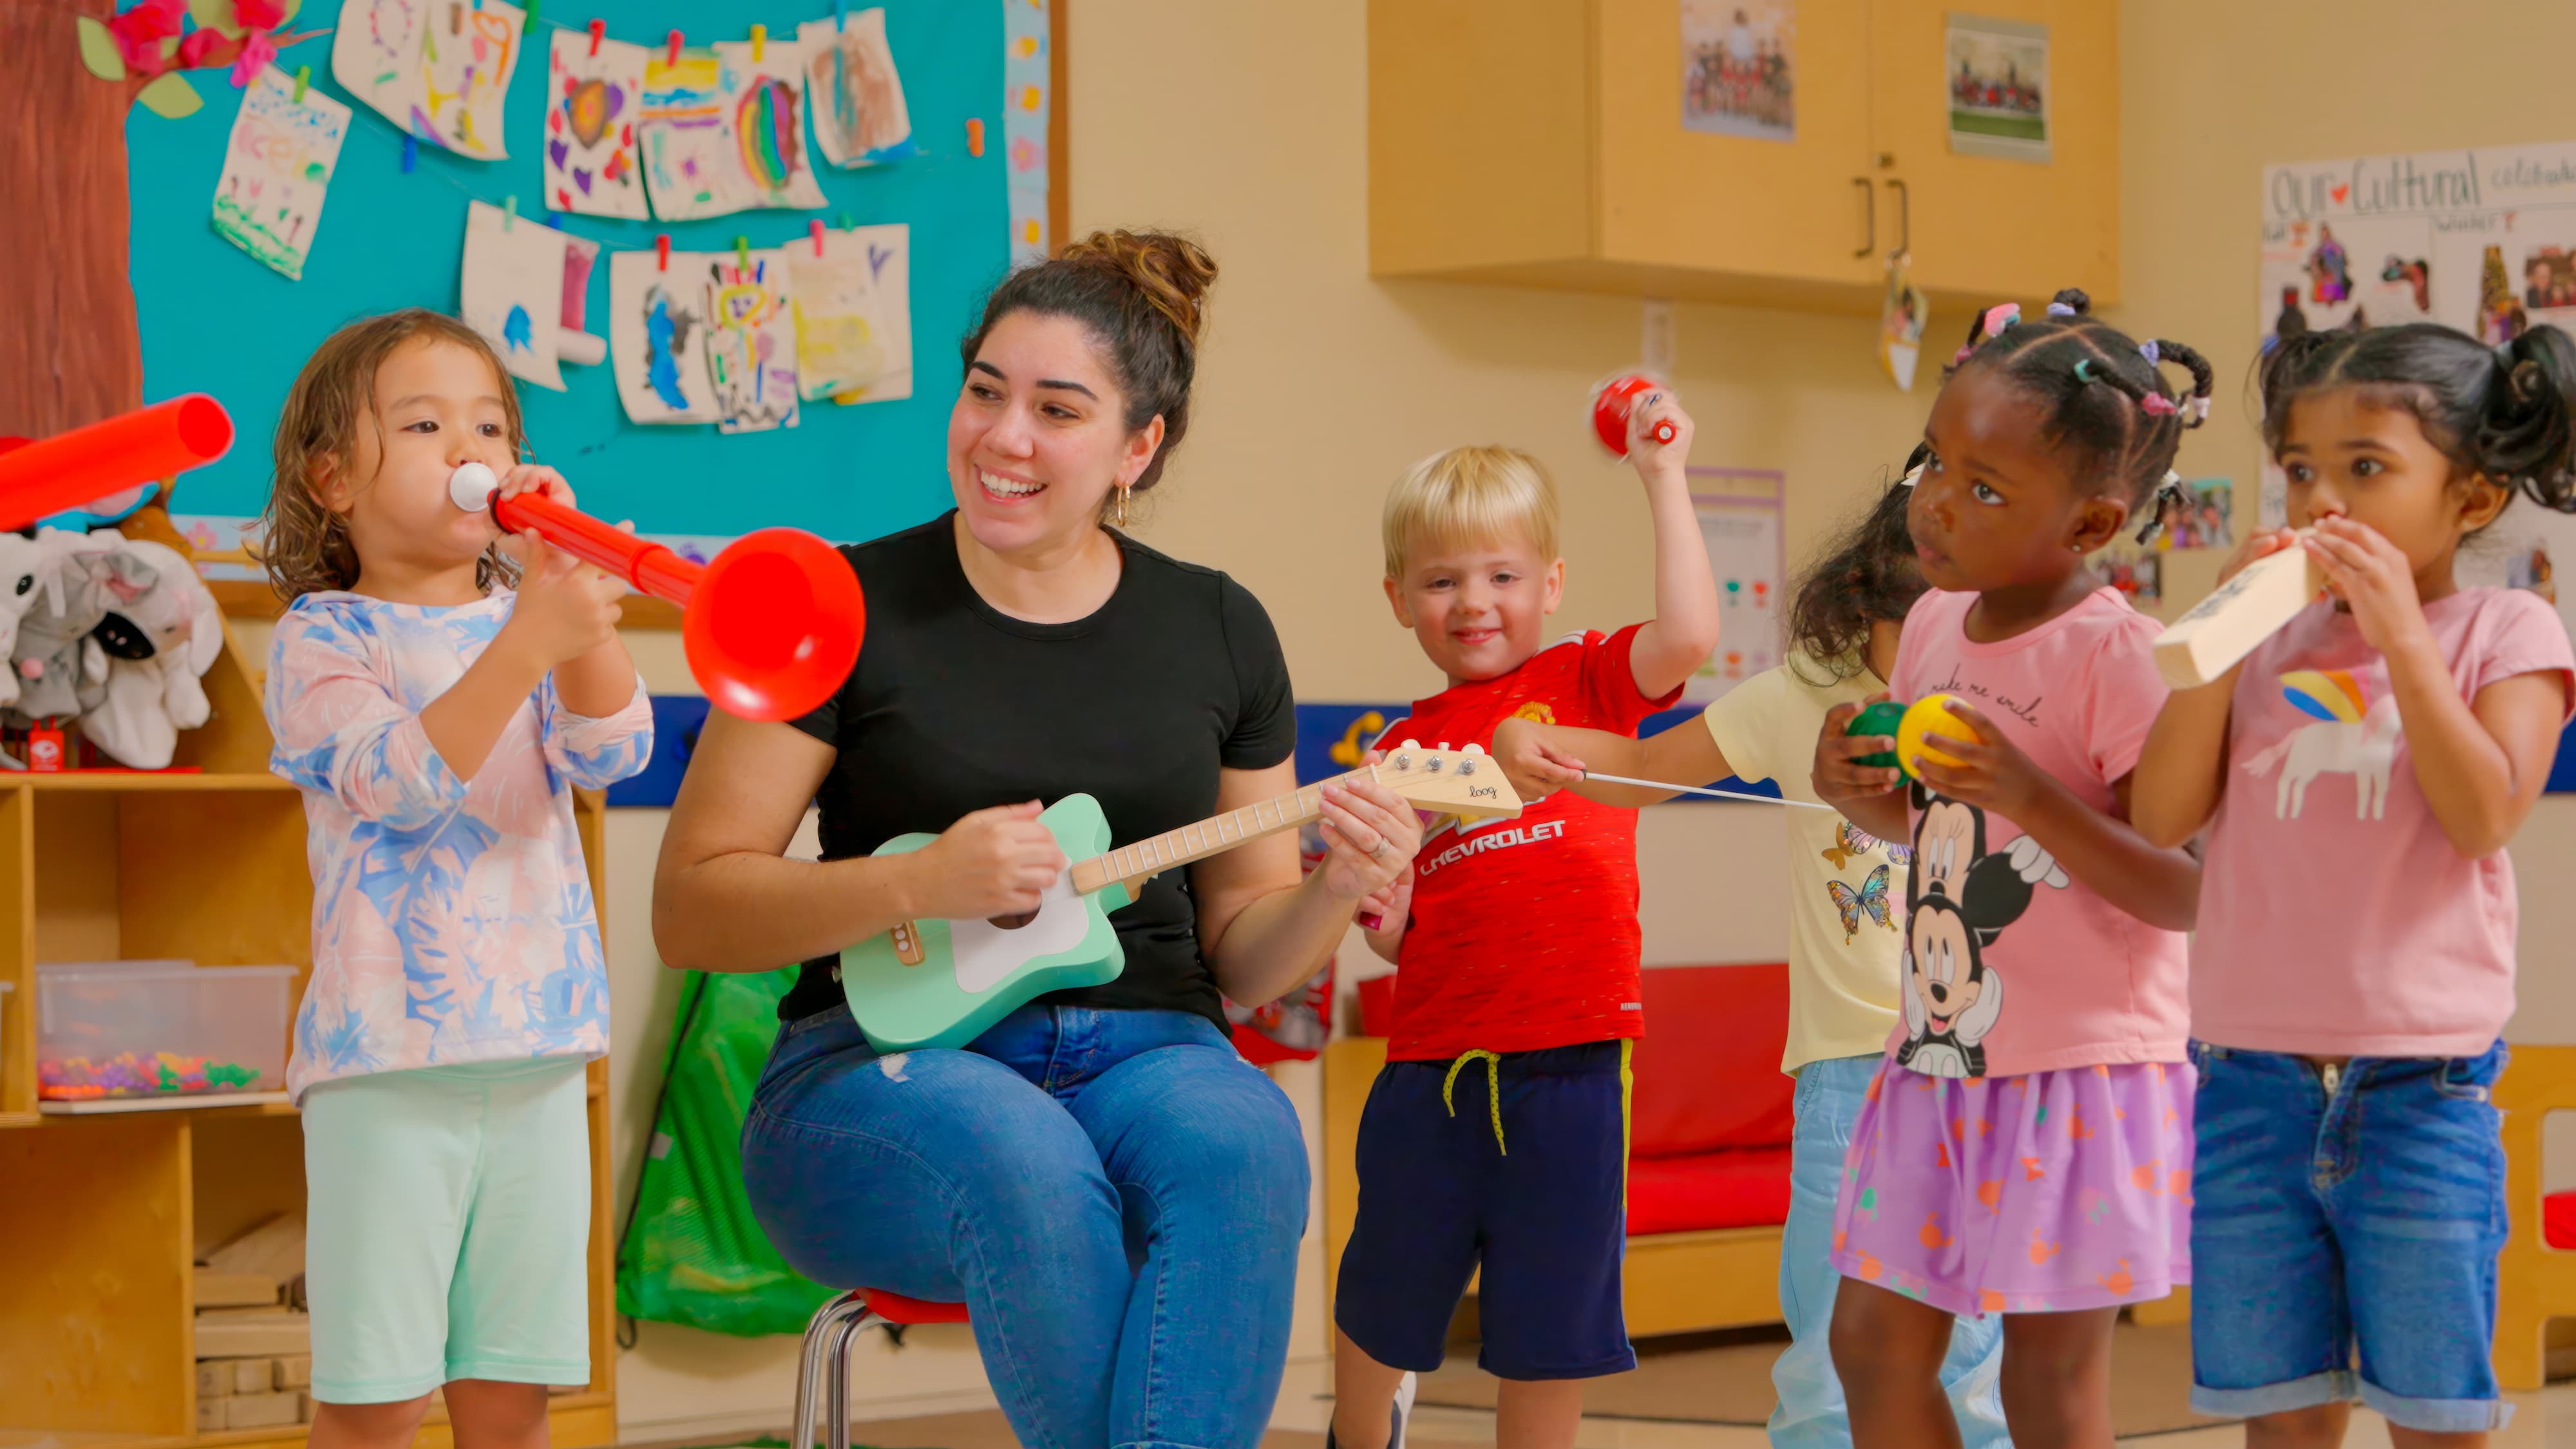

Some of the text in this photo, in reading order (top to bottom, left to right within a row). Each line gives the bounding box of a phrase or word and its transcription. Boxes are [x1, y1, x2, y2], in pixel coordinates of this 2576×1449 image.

[2352, 150, 2481, 216] Cultural
[1968, 683, 1990, 697] me
[1469, 785, 1498, 799] loog
